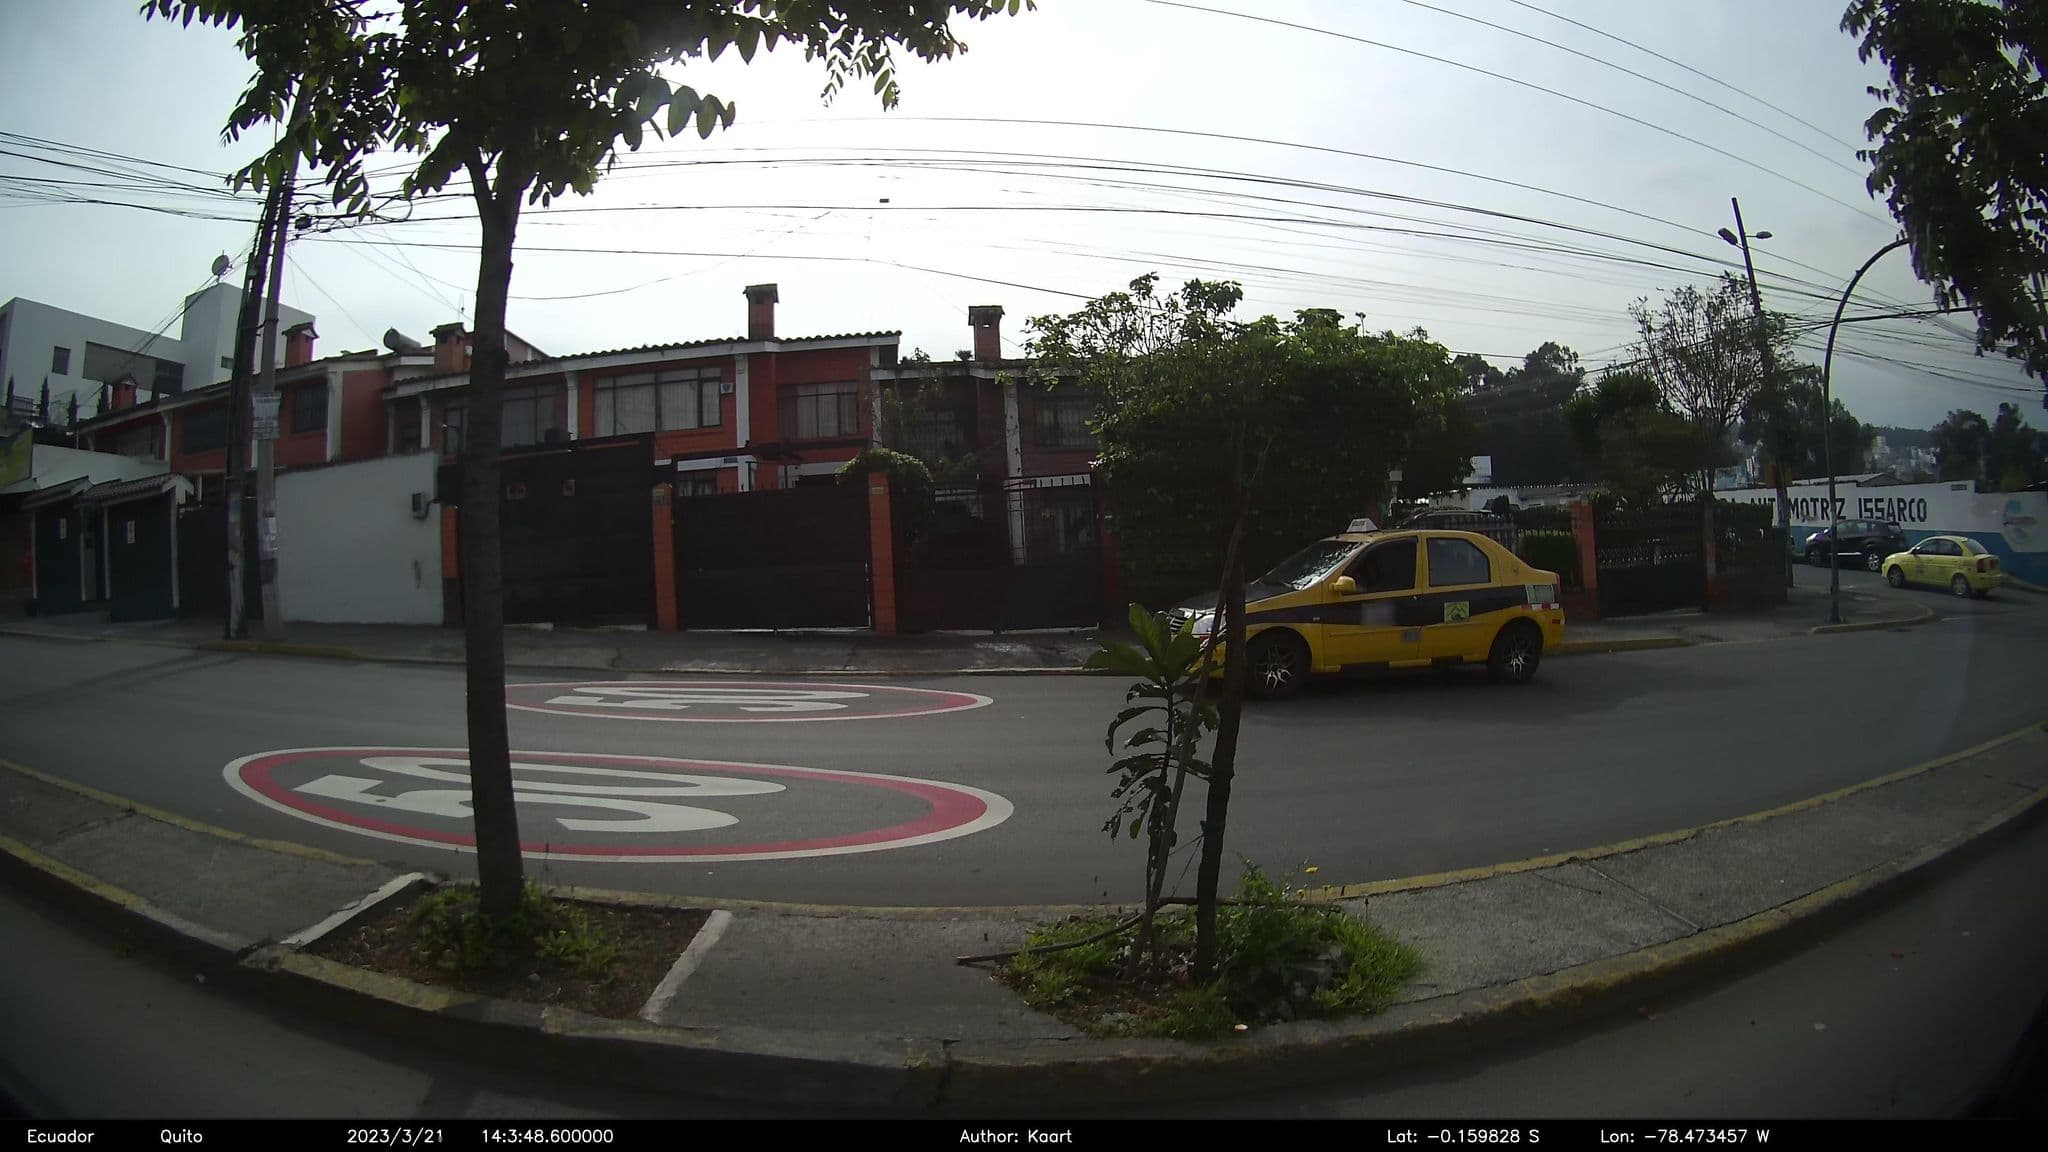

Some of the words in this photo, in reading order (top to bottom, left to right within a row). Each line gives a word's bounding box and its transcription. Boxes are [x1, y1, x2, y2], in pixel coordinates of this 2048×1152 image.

[1858, 497, 1927, 522] ISSARCO
[544, 687, 870, 712] 50
[292, 756, 787, 833] 50
